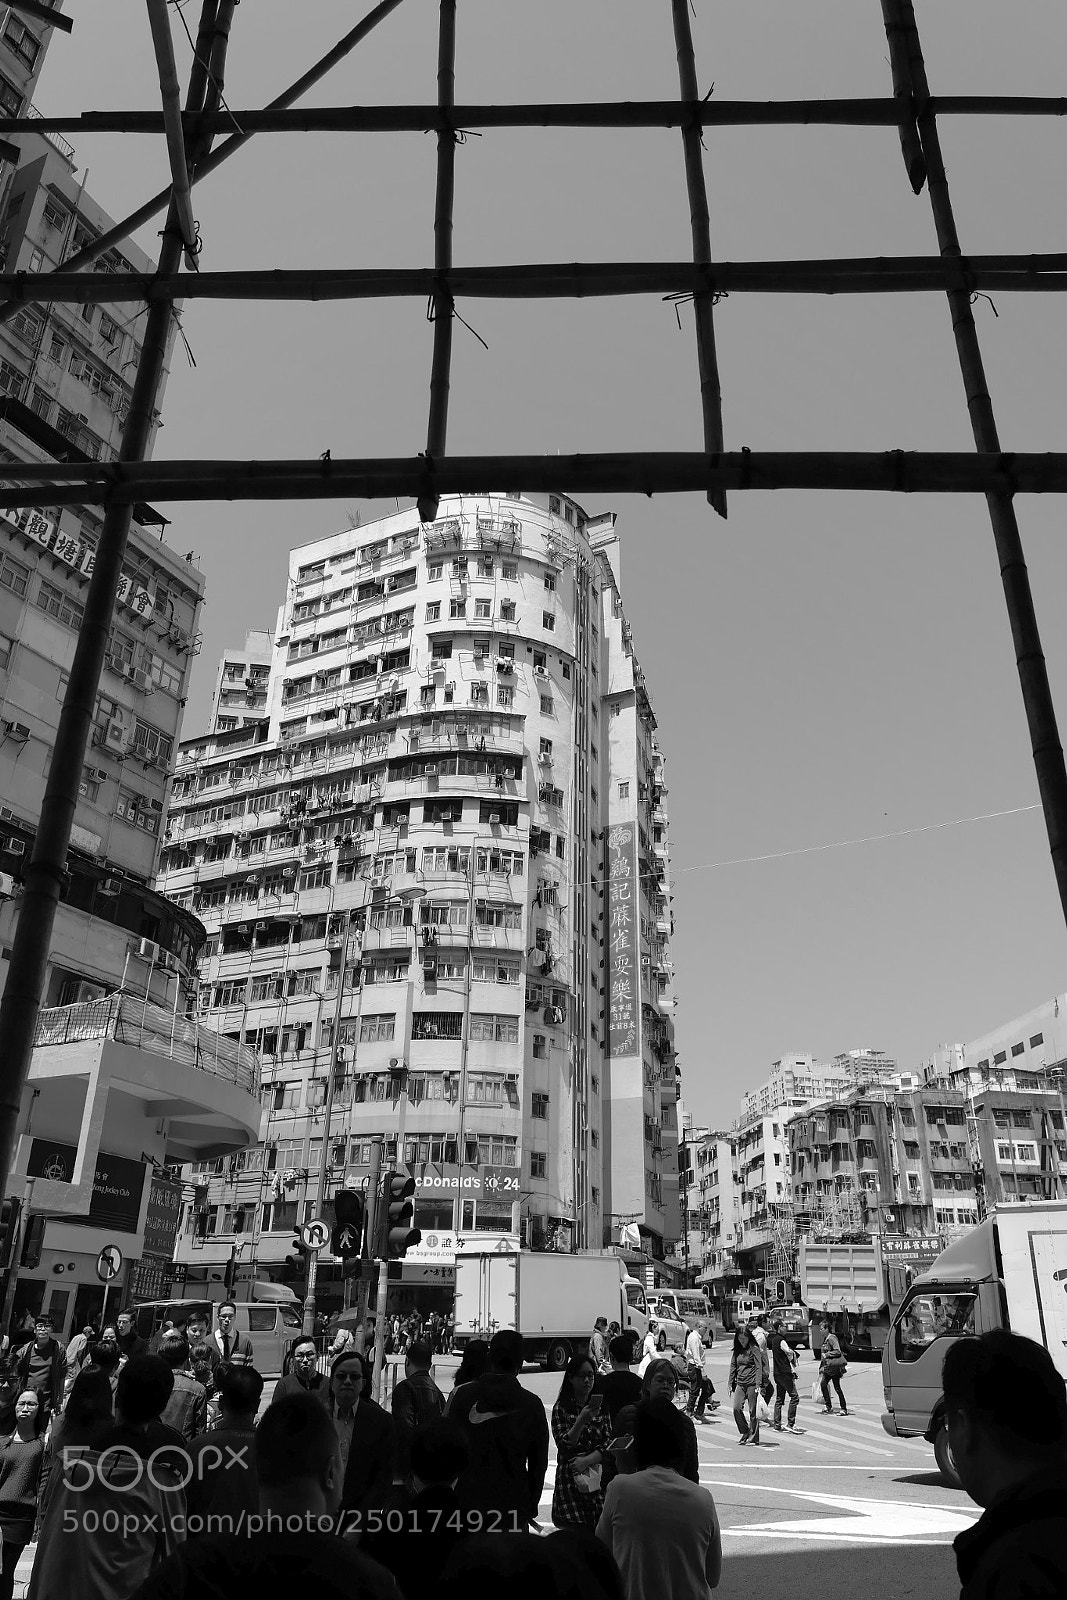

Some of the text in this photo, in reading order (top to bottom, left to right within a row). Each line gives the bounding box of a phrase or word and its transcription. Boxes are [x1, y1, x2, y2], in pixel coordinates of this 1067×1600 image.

[414, 1176, 521, 1191] cDonald's 24
[119, 1188, 131, 1197] Club
